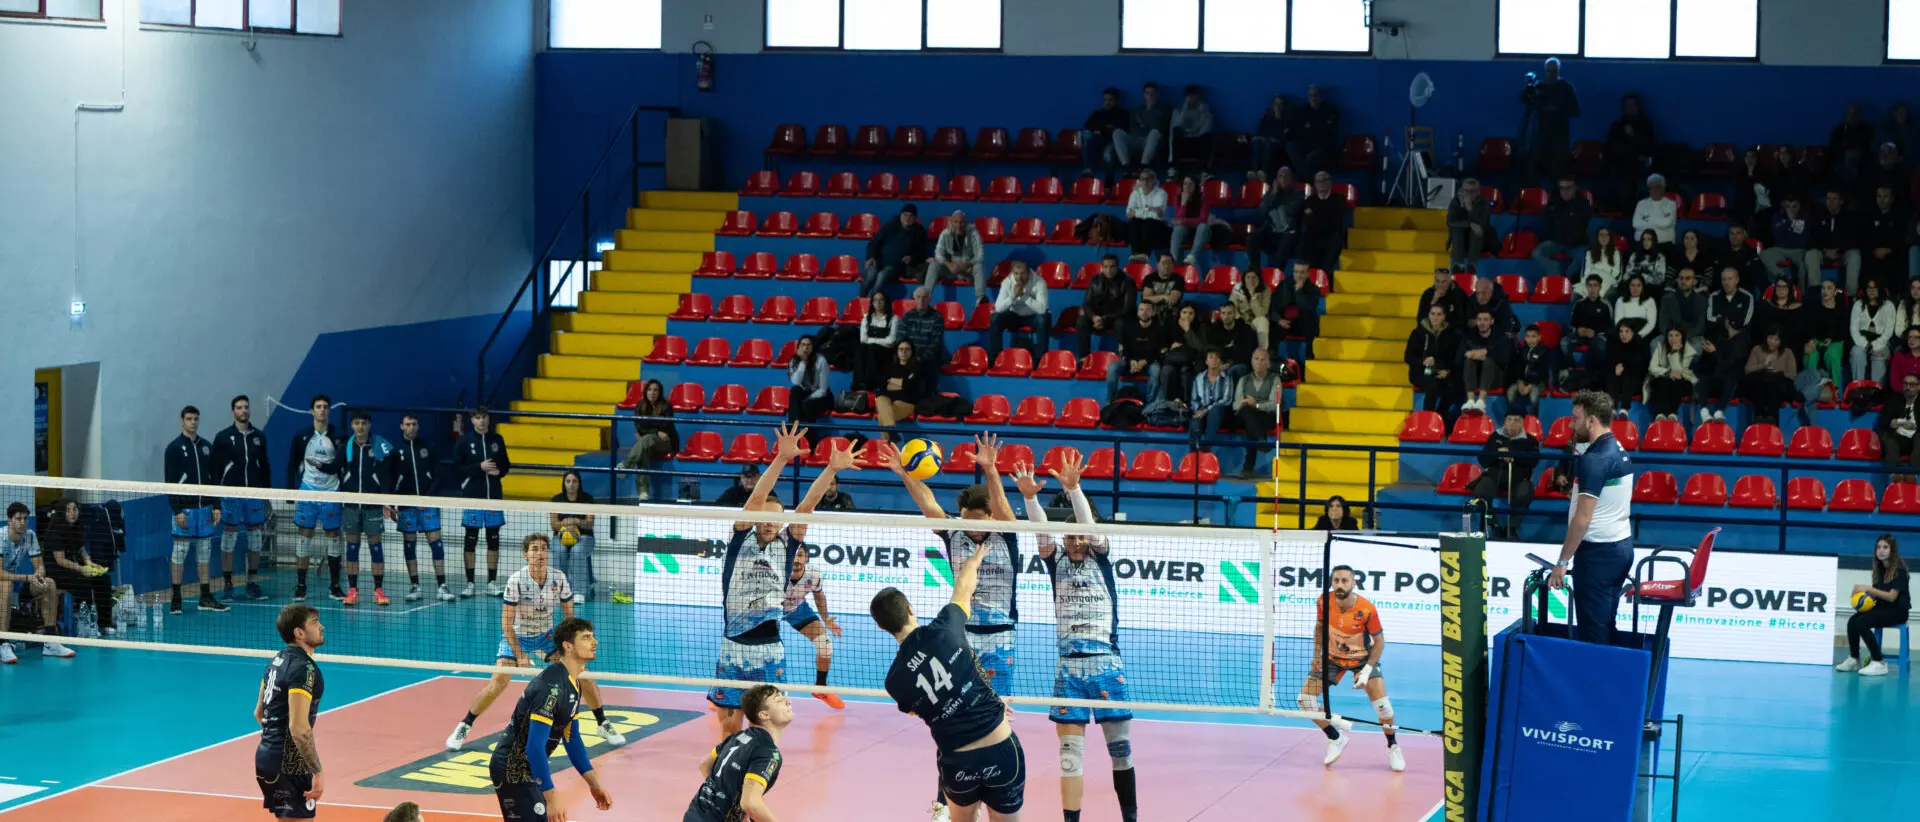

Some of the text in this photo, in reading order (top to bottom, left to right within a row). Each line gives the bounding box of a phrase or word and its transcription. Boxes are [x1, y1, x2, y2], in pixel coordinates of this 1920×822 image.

[805, 543, 911, 568] POWER
[1112, 558, 1206, 582] OWER
[1279, 566, 1386, 591] SMRT
[1441, 551, 1462, 641] BANCA
[1707, 587, 1828, 613] POWER
[1675, 613, 1826, 630] #Innovazione #Ricerca
[906, 650, 928, 672] SALA
[915, 656, 954, 705] 14
[1443, 651, 1464, 754] CREDEM
[1522, 726, 1614, 751] VIVISPORT
[716, 746, 740, 777] 1
